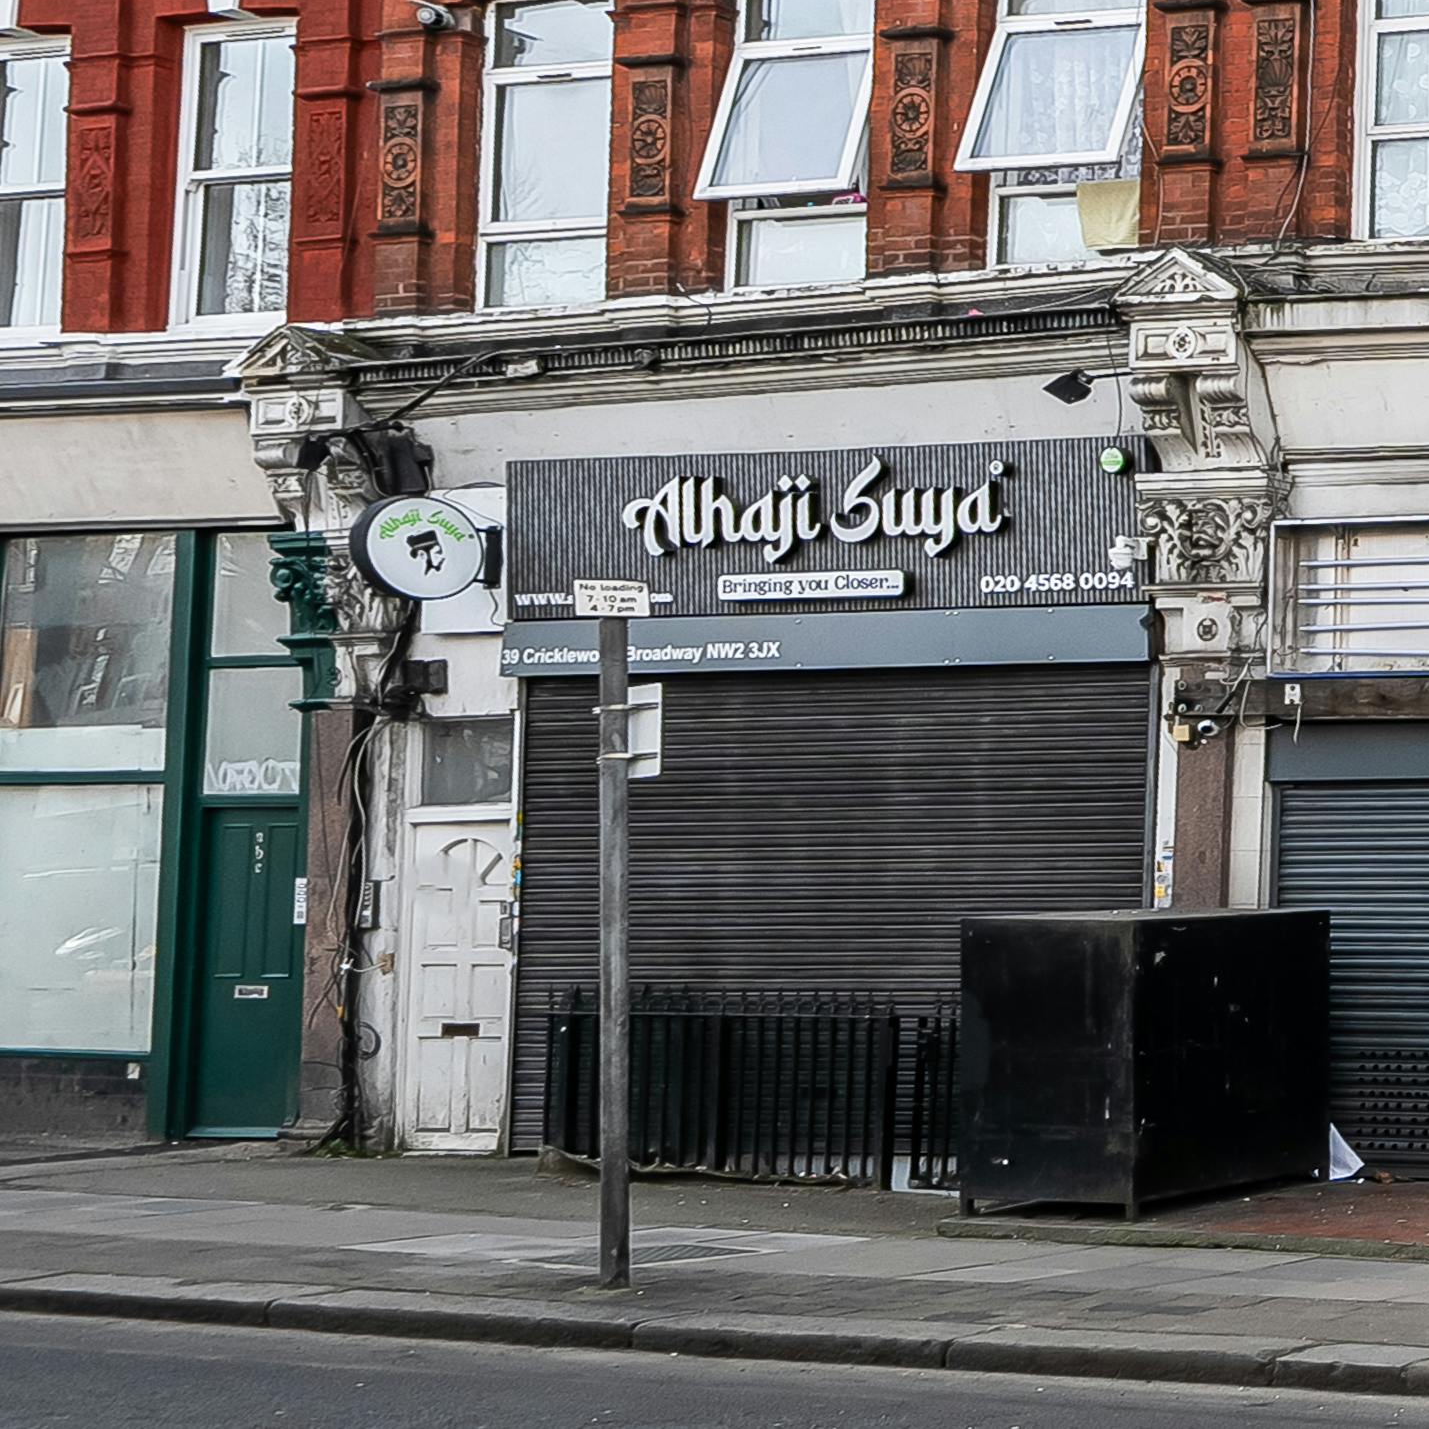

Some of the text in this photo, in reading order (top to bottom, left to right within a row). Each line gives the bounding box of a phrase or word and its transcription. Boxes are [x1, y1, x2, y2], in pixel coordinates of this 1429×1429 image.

[622, 454, 1003, 564] Alhaji Suya
[579, 583, 644, 594] No loading
[722, 578, 794, 596] Bringing
[797, 577, 829, 594] you
[980, 571, 1135, 593] 020 4568 0094
[586, 594, 594, 603] 7
[602, 594, 617, 603] 10
[590, 604, 598, 612] 4
[608, 604, 615, 612] 7
[502, 651, 519, 665] 39
[523, 647, 600, 664] Cricklewo
[706, 642, 745, 659] NW2
[748, 641, 781, 658] 3JX
